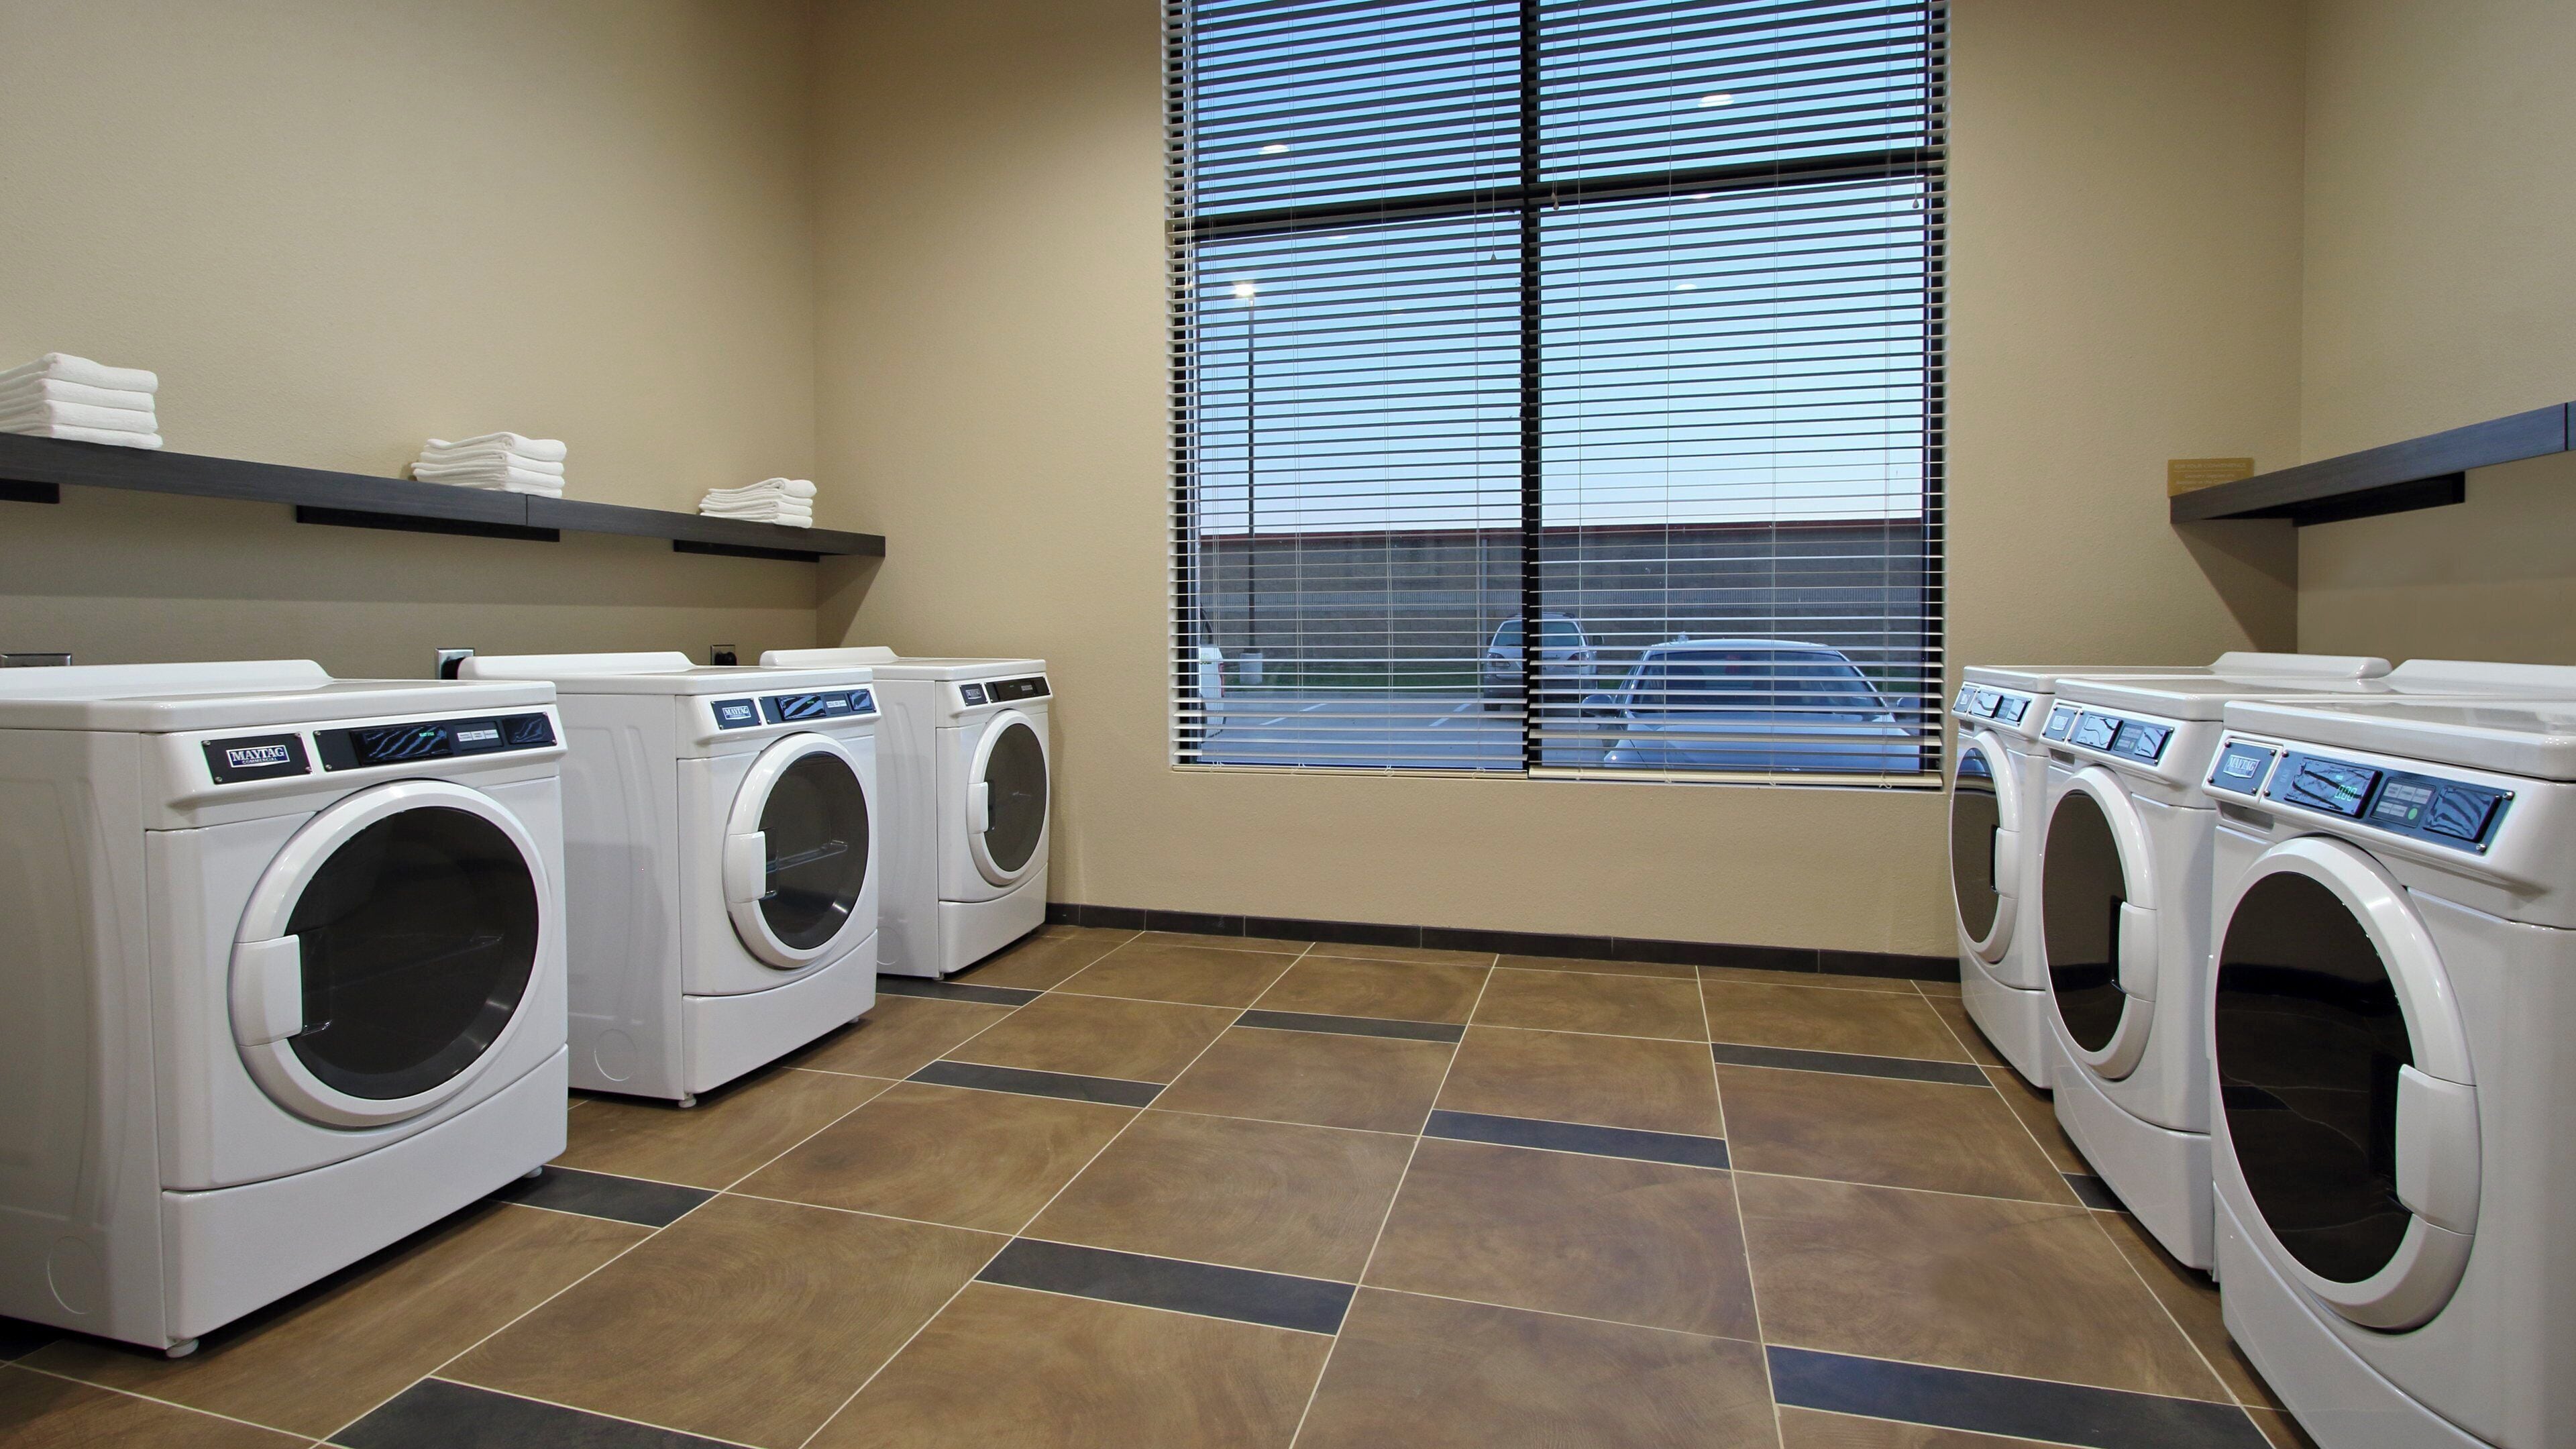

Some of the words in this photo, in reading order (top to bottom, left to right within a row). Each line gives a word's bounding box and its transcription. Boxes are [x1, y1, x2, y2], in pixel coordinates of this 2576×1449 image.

[724, 707, 748, 715] MAYTAG
[231, 747, 284, 761] MAYTAG
[2228, 757, 2255, 771] MAYTAG
